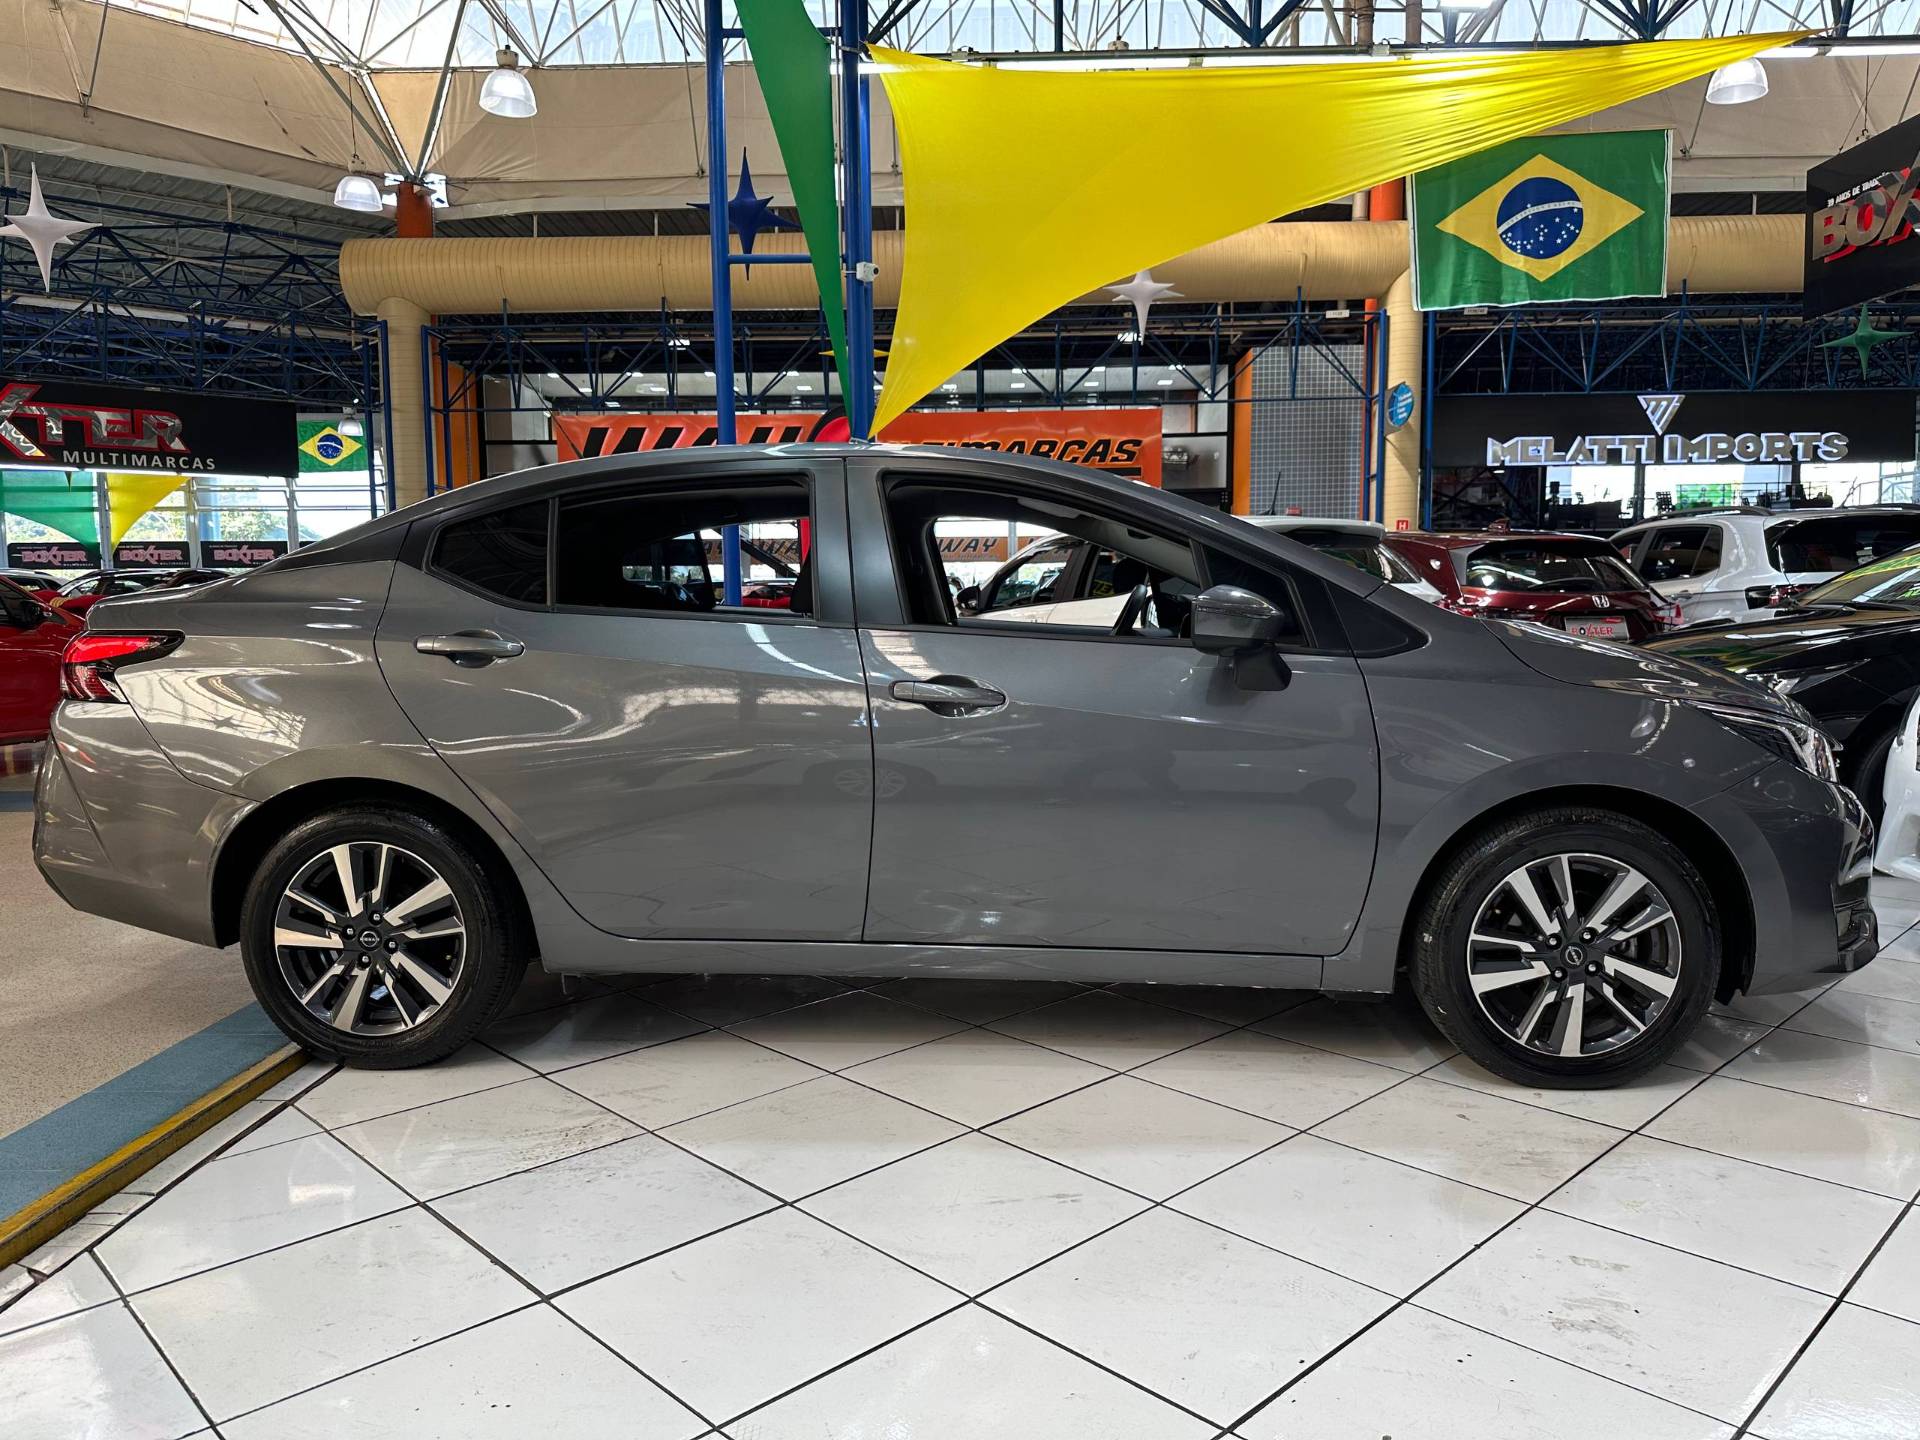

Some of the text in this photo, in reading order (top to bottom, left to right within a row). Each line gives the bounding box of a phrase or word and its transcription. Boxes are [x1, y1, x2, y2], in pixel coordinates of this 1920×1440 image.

[1486, 431, 1849, 467] MELATTI IMPORTS
[63, 450, 216, 470] MULTIMARCAS
[21, 545, 88, 566] BOXTER
[119, 545, 183, 565] BOXTER
[214, 544, 276, 565] BOXTER
